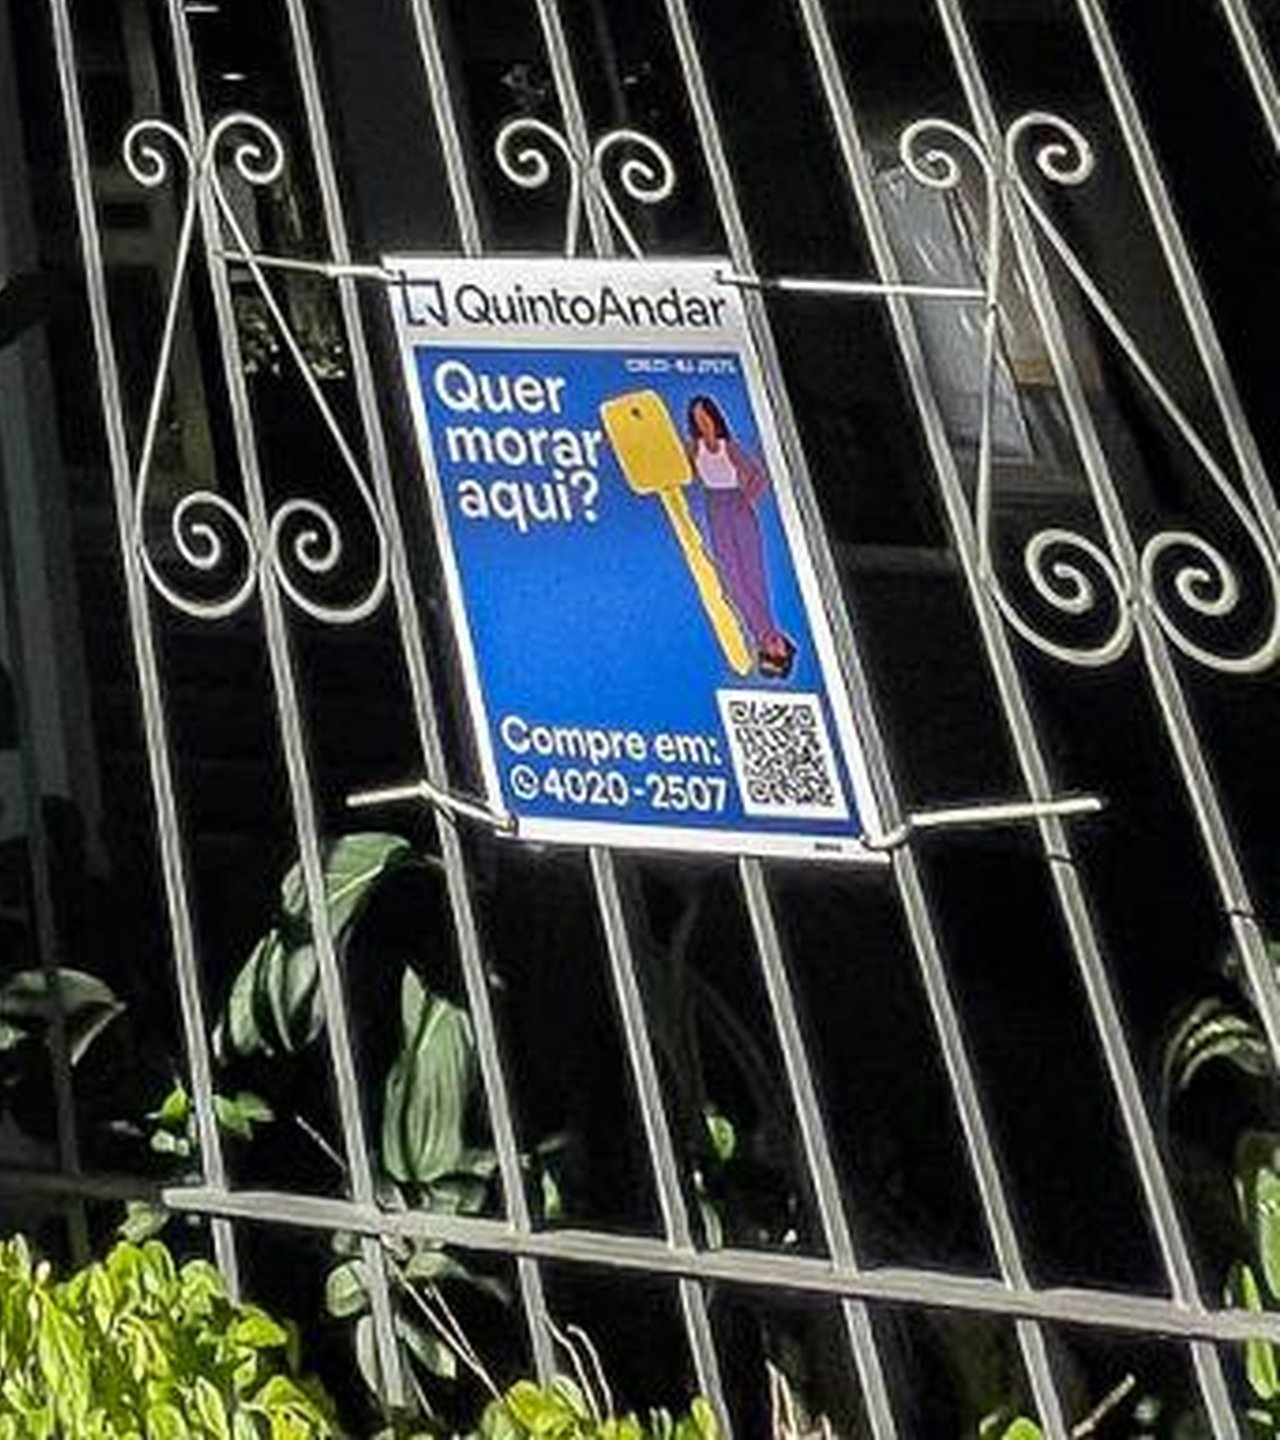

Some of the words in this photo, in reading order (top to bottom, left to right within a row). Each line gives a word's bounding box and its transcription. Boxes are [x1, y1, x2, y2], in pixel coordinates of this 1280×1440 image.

[454, 283, 727, 328] QuintoAndar
[434, 360, 566, 414] Quer
[446, 426, 602, 468] morar
[458, 469, 600, 533] aqui?
[500, 714, 648, 766] Compre
[653, 738, 723, 766] em:
